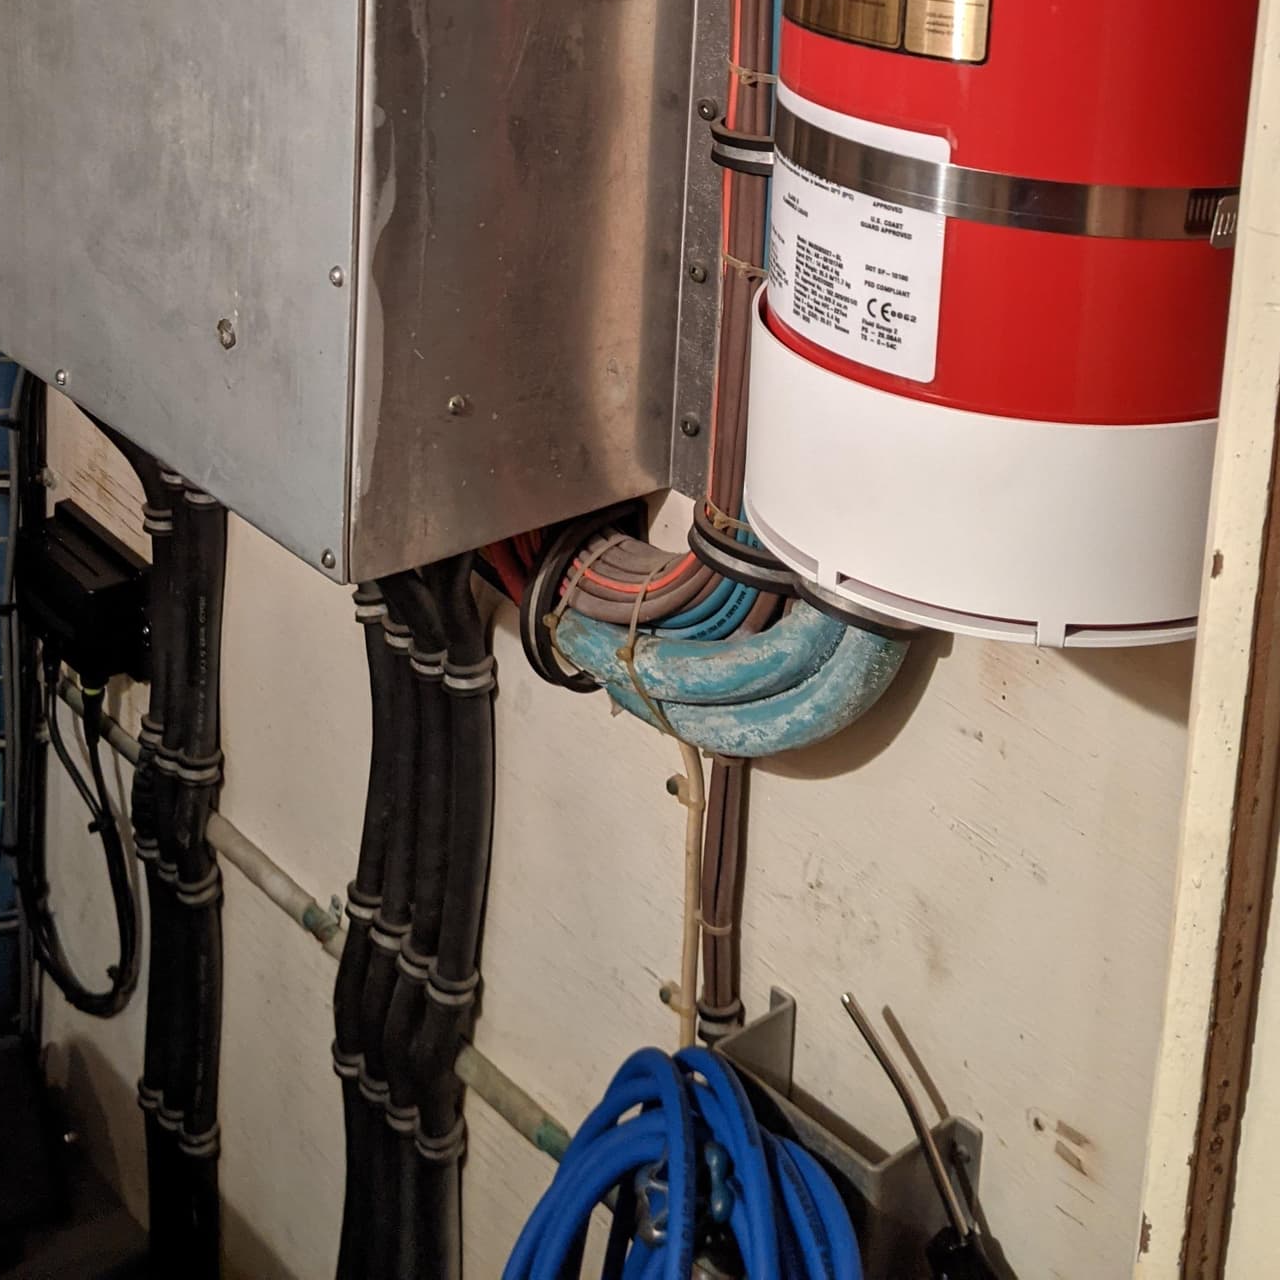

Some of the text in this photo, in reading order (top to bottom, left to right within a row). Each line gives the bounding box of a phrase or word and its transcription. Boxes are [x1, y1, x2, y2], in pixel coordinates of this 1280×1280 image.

[873, 201, 903, 214] APPROVED
[860, 221, 912, 240] GUARD APPROVED
[883, 220, 904, 230] COAST
[876, 283, 911, 298] COMPLIANT
